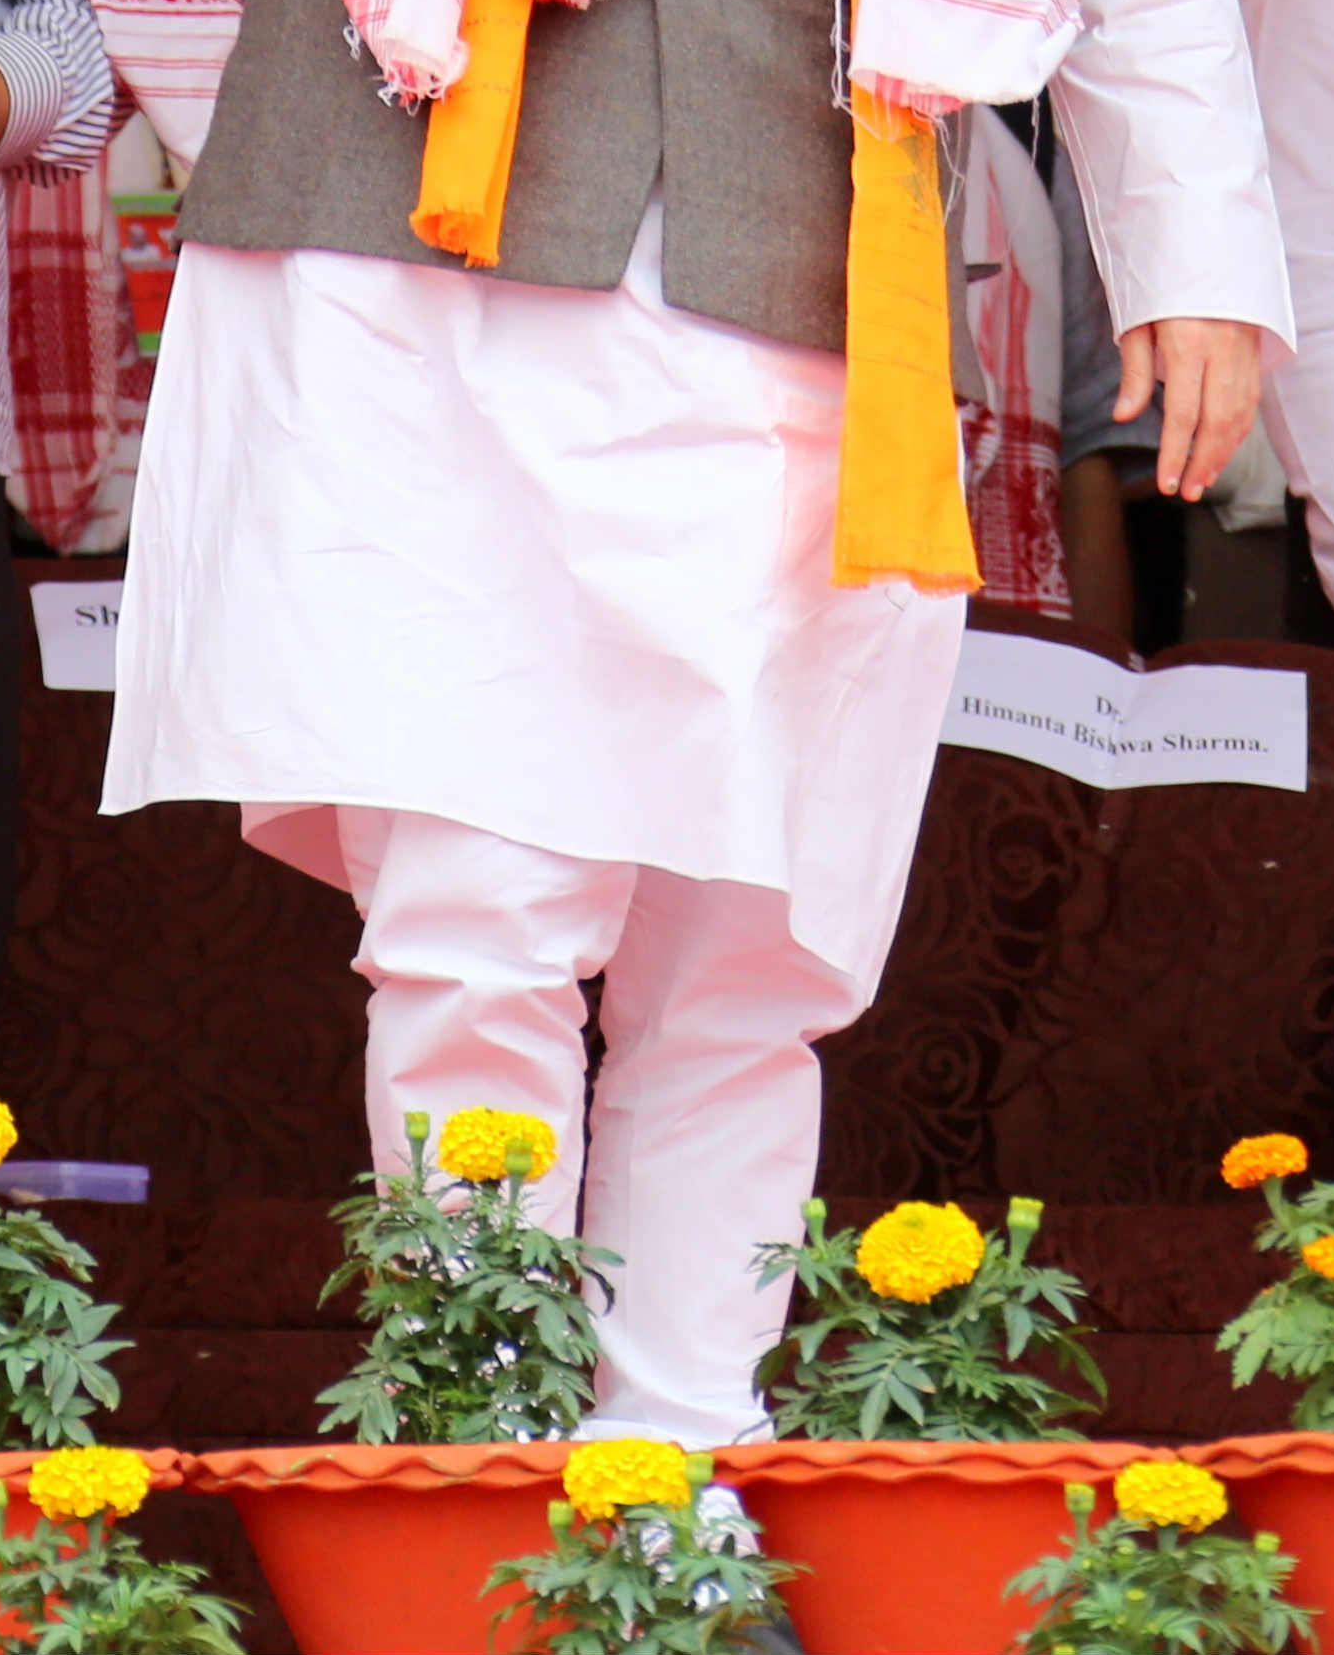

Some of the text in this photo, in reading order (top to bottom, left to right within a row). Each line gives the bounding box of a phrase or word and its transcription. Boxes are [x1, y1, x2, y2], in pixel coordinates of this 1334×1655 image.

[74, 605, 119, 627] Sh
[962, 695, 1066, 736] Himanta
[1162, 733, 1269, 753] Sharma.
[1095, 694, 1124, 725] Dr.
